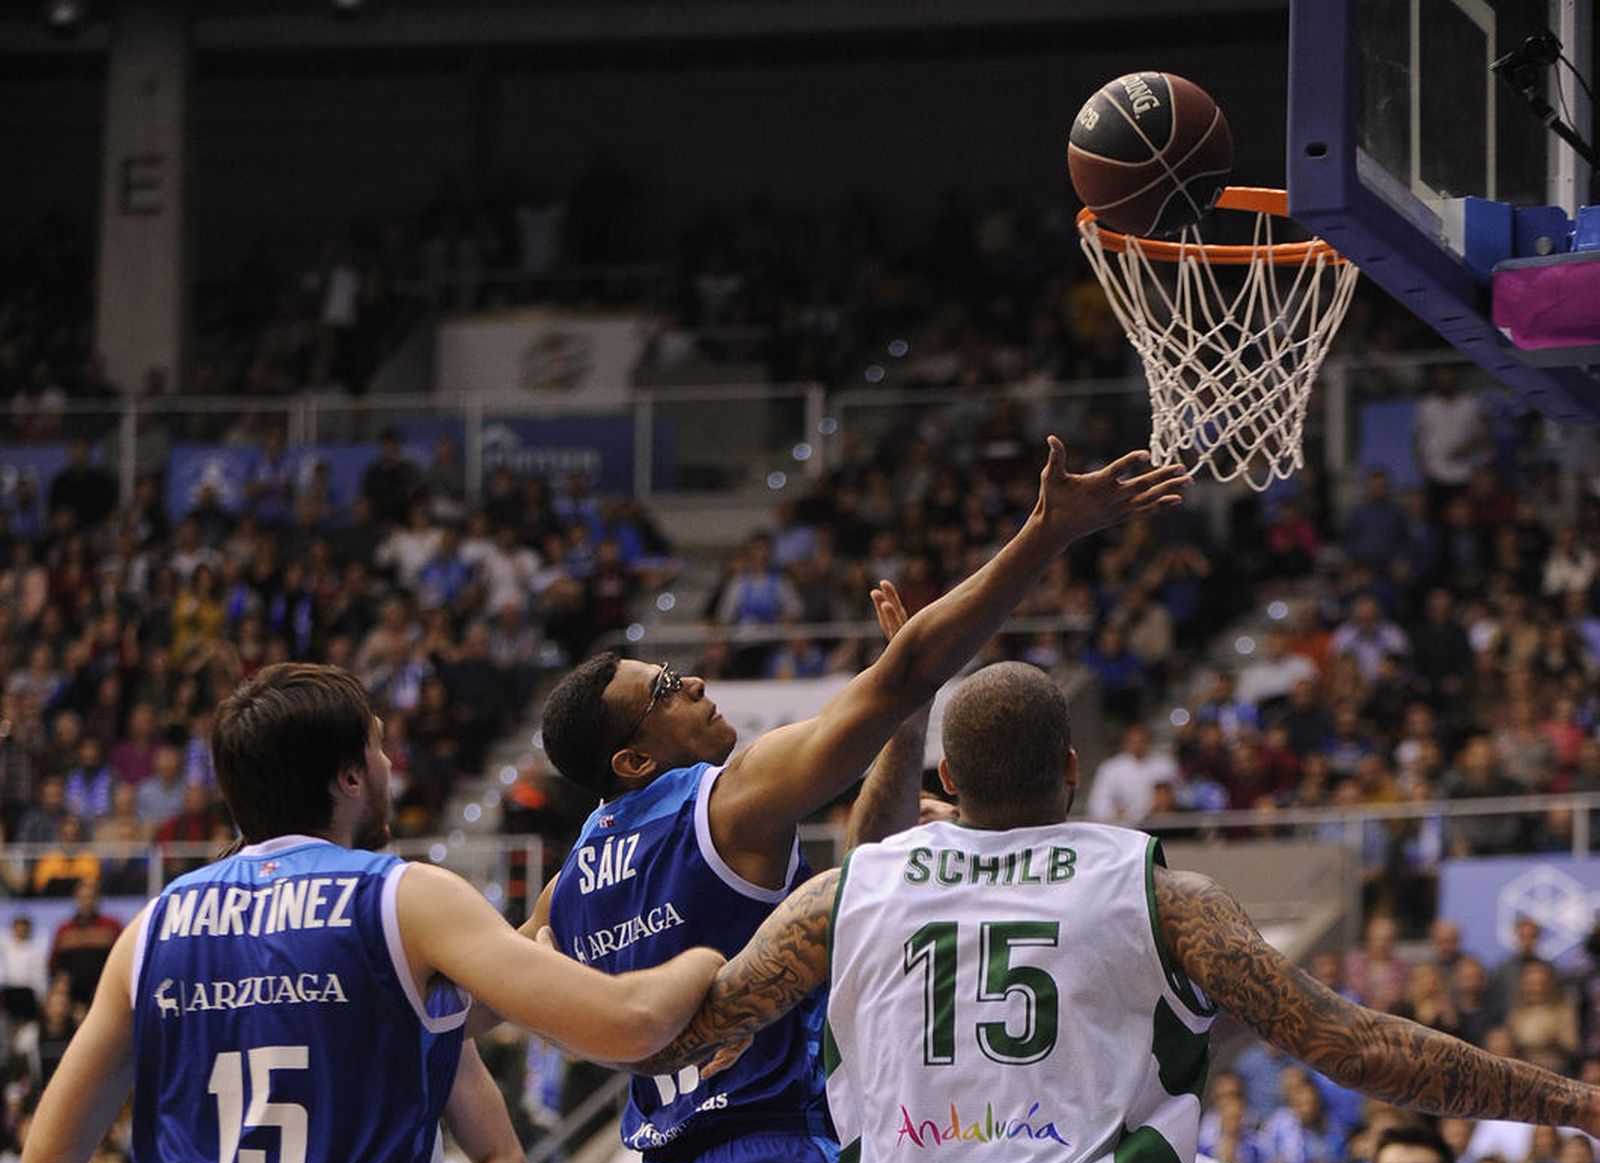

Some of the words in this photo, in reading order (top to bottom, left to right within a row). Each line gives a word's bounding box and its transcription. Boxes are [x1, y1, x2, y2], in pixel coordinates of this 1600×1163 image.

[120, 155, 163, 216] E
[578, 833, 640, 894] SÁIZ
[904, 846, 1077, 887] SCHILB
[159, 877, 359, 941] MARTÍNEZ
[186, 972, 349, 1012] ARZUAGA
[904, 921, 1060, 1066] 15
